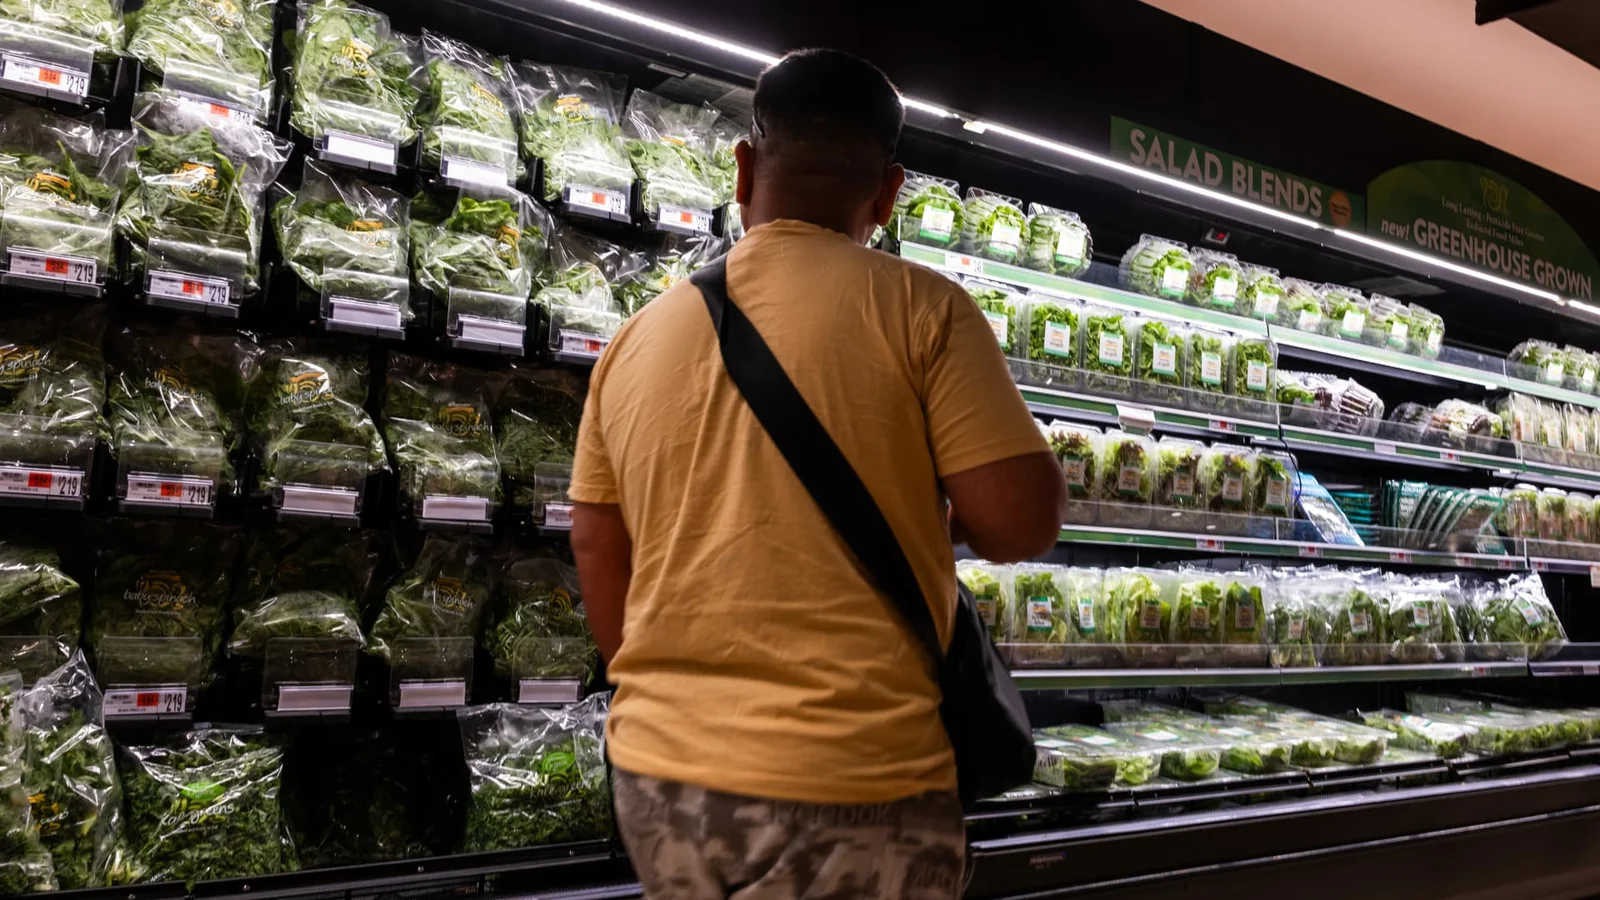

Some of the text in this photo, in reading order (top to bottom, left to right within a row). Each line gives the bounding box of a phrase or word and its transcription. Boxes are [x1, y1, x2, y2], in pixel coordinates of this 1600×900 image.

[1130, 129, 1322, 217] SALAD BLENDS
[1442, 196, 1458, 213] Long
[1381, 217, 1592, 299] new! GREENHOUSE GROWN
[123, 588, 197, 608] baby spinach
[161, 809, 187, 826] kal
